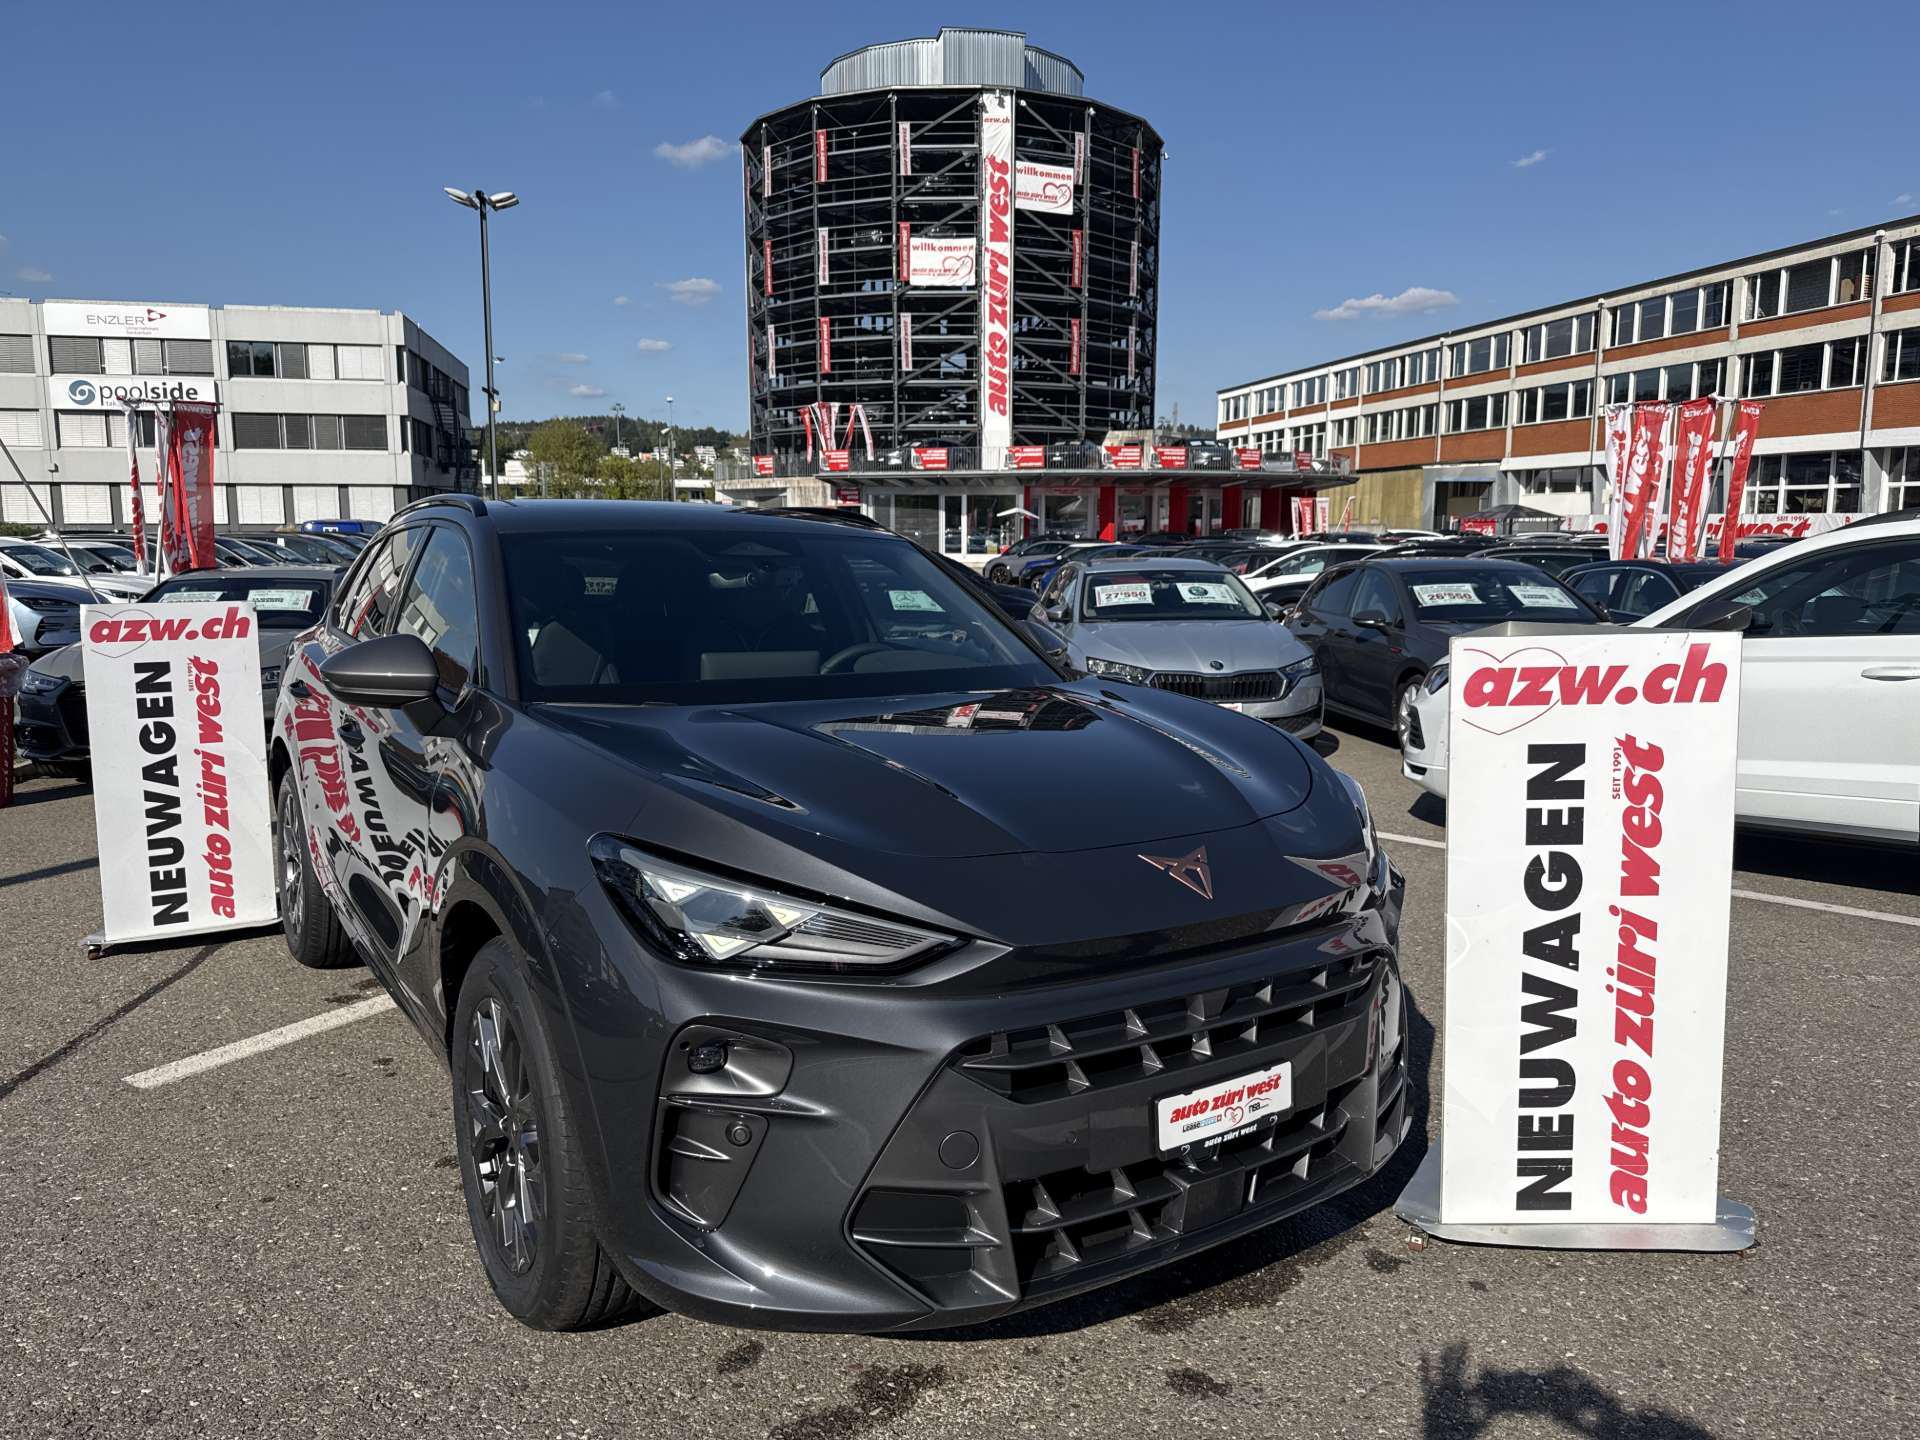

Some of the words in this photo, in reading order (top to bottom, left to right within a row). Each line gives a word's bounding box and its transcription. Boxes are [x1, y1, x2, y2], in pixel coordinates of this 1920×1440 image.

[986, 153, 1009, 242] west
[1016, 166, 1072, 181] willkommen
[911, 242, 974, 252] willkommen
[86, 315, 145, 325] ENZLER
[985, 246, 1009, 331] züri
[99, 380, 198, 406] poolside
[986, 331, 1008, 416] auto
[89, 606, 250, 643] azw.ch
[1105, 592, 1146, 600] 27'550
[187, 676, 195, 692] SEIT
[187, 655, 225, 748] west
[1463, 643, 1728, 708] azw.ch
[1612, 747, 1622, 768] 1991
[1612, 771, 1622, 800] SEIT
[134, 661, 189, 926] NEUWAGEN
[193, 749, 232, 832] züri
[1614, 733, 1665, 897] west
[200, 832, 236, 920] auto
[1516, 742, 1586, 1211] NEUWAGEN
[1606, 904, 1659, 1057] züri
[1170, 1098, 1210, 1124] auto
[1211, 1085, 1246, 1111] züri
[1247, 1073, 1281, 1099] west
[1204, 1136, 1222, 1147] auto
[1223, 1130, 1240, 1142] züri
[1240, 1124, 1257, 1135] west
[1602, 1058, 1653, 1215] auto
